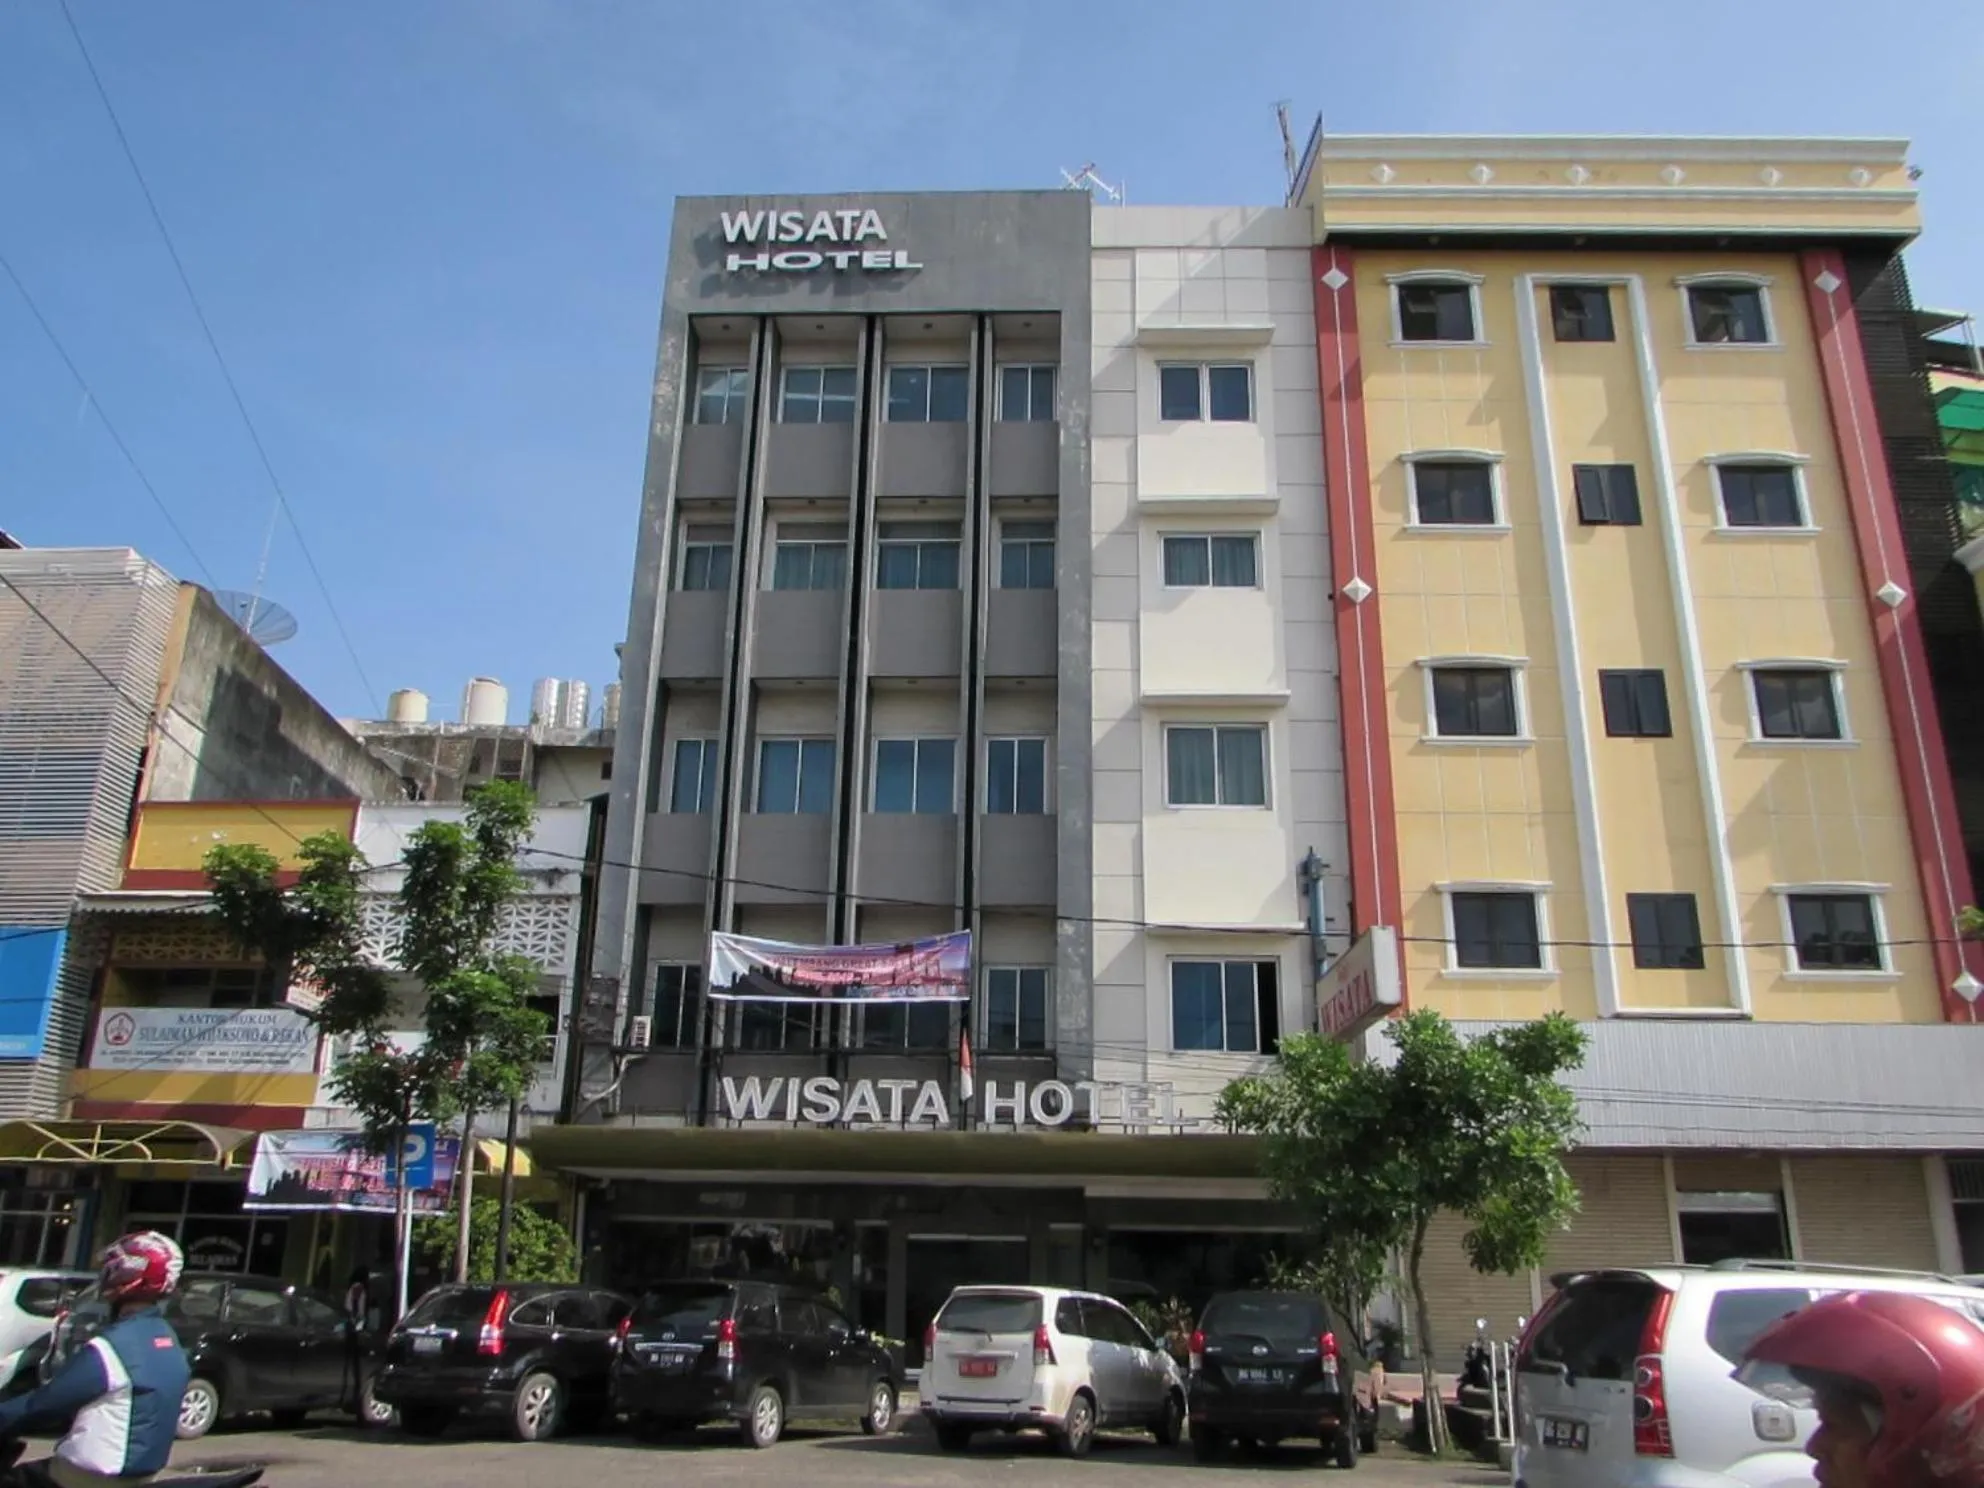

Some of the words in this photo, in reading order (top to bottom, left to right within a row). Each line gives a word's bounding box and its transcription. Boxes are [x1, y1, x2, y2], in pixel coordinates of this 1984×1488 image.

[720, 209, 888, 243] WISATA
[726, 250, 924, 272] HOTEL
[722, 1074, 950, 1124] WISATA
[984, 1078, 1200, 1127] HOTEL
[395, 1133, 427, 1186] P
